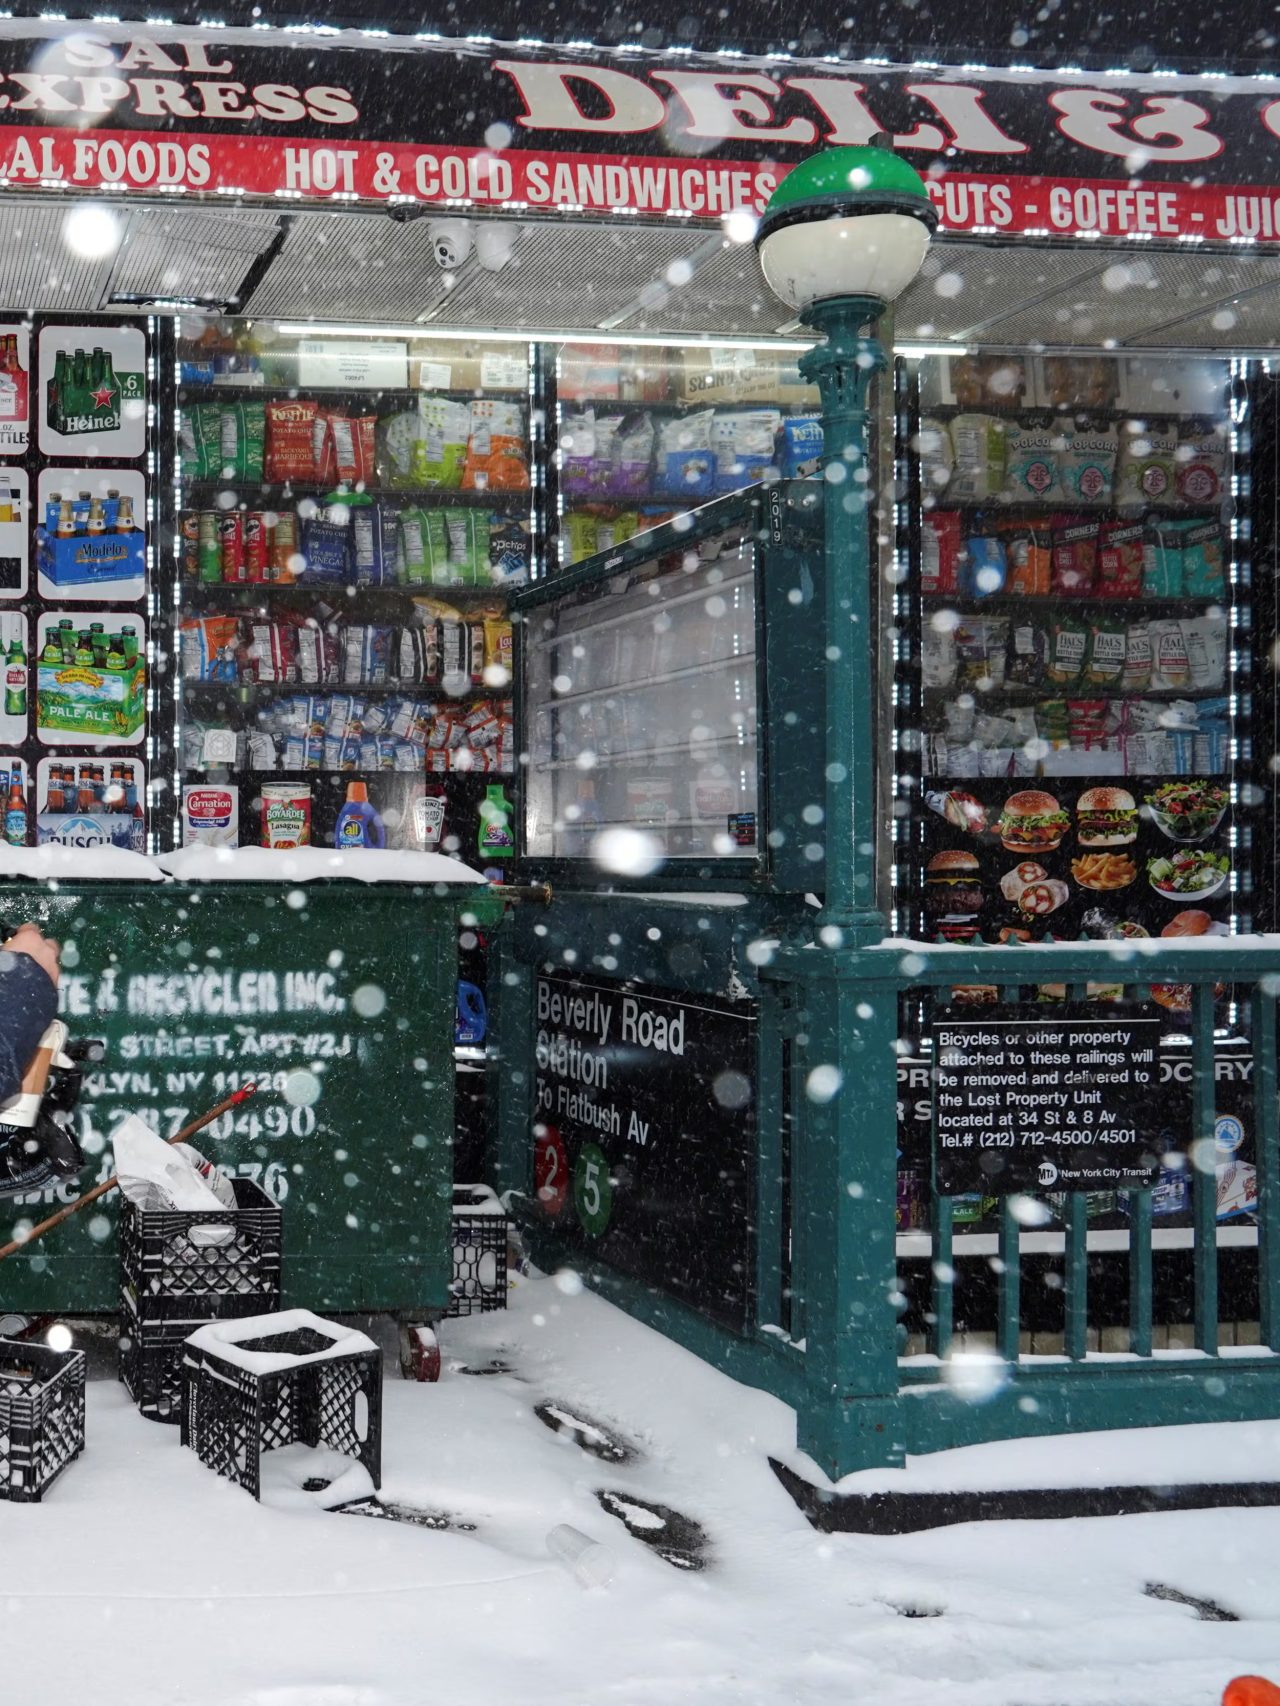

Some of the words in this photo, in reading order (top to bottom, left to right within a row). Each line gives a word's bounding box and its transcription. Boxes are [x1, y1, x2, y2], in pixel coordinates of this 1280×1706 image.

[64, 35, 232, 74] SAL
[492, 60, 1030, 154] DELI
[1048, 89, 1225, 162] &
[74, 139, 210, 186] FOODS
[285, 149, 358, 191] HOT
[372, 152, 400, 194] &
[416, 153, 512, 200] COLD
[526, 159, 775, 215] SANDWICHES
[926, 182, 1012, 225] CUTS
[1050, 186, 1179, 233] COFFEE
[126, 376, 137, 389] 6
[1067, 440, 1118, 451] POPCORN
[1065, 523, 1100, 538] CORNERS
[1109, 525, 1143, 540] CORNERS
[83, 543, 122, 557] Modelo
[50, 707, 80, 718] PALE
[86, 711, 110, 721] ALE
[188, 796, 231, 811] Carnation
[267, 809, 305, 819] BOYARDEE
[271, 822, 300, 830] Lasagna
[346, 825, 358, 836] all
[285, 972, 346, 1013] INC.
[537, 982, 611, 1045] Beverly
[622, 998, 685, 1056] Road
[939, 1031, 1000, 1046] Bicycles
[1005, 1035, 1019, 1046] or
[1026, 1031, 1064, 1045] other
[1069, 1030, 1131, 1047] property
[536, 1030, 607, 1089] Station
[939, 1052, 1004, 1066] attached
[1010, 1053, 1025, 1065] to
[1030, 1051, 1070, 1065] these
[1076, 1050, 1126, 1066] railings
[1131, 1049, 1153, 1063] will
[167, 1072, 204, 1093] NY
[939, 1071, 958, 1087] be
[963, 1070, 1027, 1086] removed
[1031, 1070, 1059, 1085] and
[1063, 1069, 1129, 1084] delivered
[1134, 1070, 1149, 1083] to
[939, 1093, 963, 1107] the
[968, 1092, 1001, 1106] Lost
[1006, 1091, 1068, 1109] Property
[1073, 1091, 1102, 1105] Unit
[537, 1078, 552, 1109] To
[557, 1086, 620, 1136] Flatbush
[627, 1111, 648, 1145] Av
[938, 1112, 993, 1127] located
[998, 1113, 1013, 1126] at
[1019, 1112, 1038, 1125] 34
[1044, 1111, 1061, 1125] St
[1066, 1111, 1077, 1124] &
[1083, 1110, 1093, 1124] 8
[1098, 1110, 1116, 1124] Av
[939, 1133, 974, 1148] Tel.#
[980, 1131, 1015, 1149] (212)
[1020, 1129, 1136, 1147] 712-4500/4501
[545, 1146, 558, 1196] 2
[584, 1162, 600, 1215] 5
[1037, 1169, 1055, 1182] MTA
[1062, 1168, 1080, 1178] New
[1082, 1168, 1101, 1178] York
[1102, 1168, 1121, 1180] City
[1123, 1166, 1152, 1177] Transit
